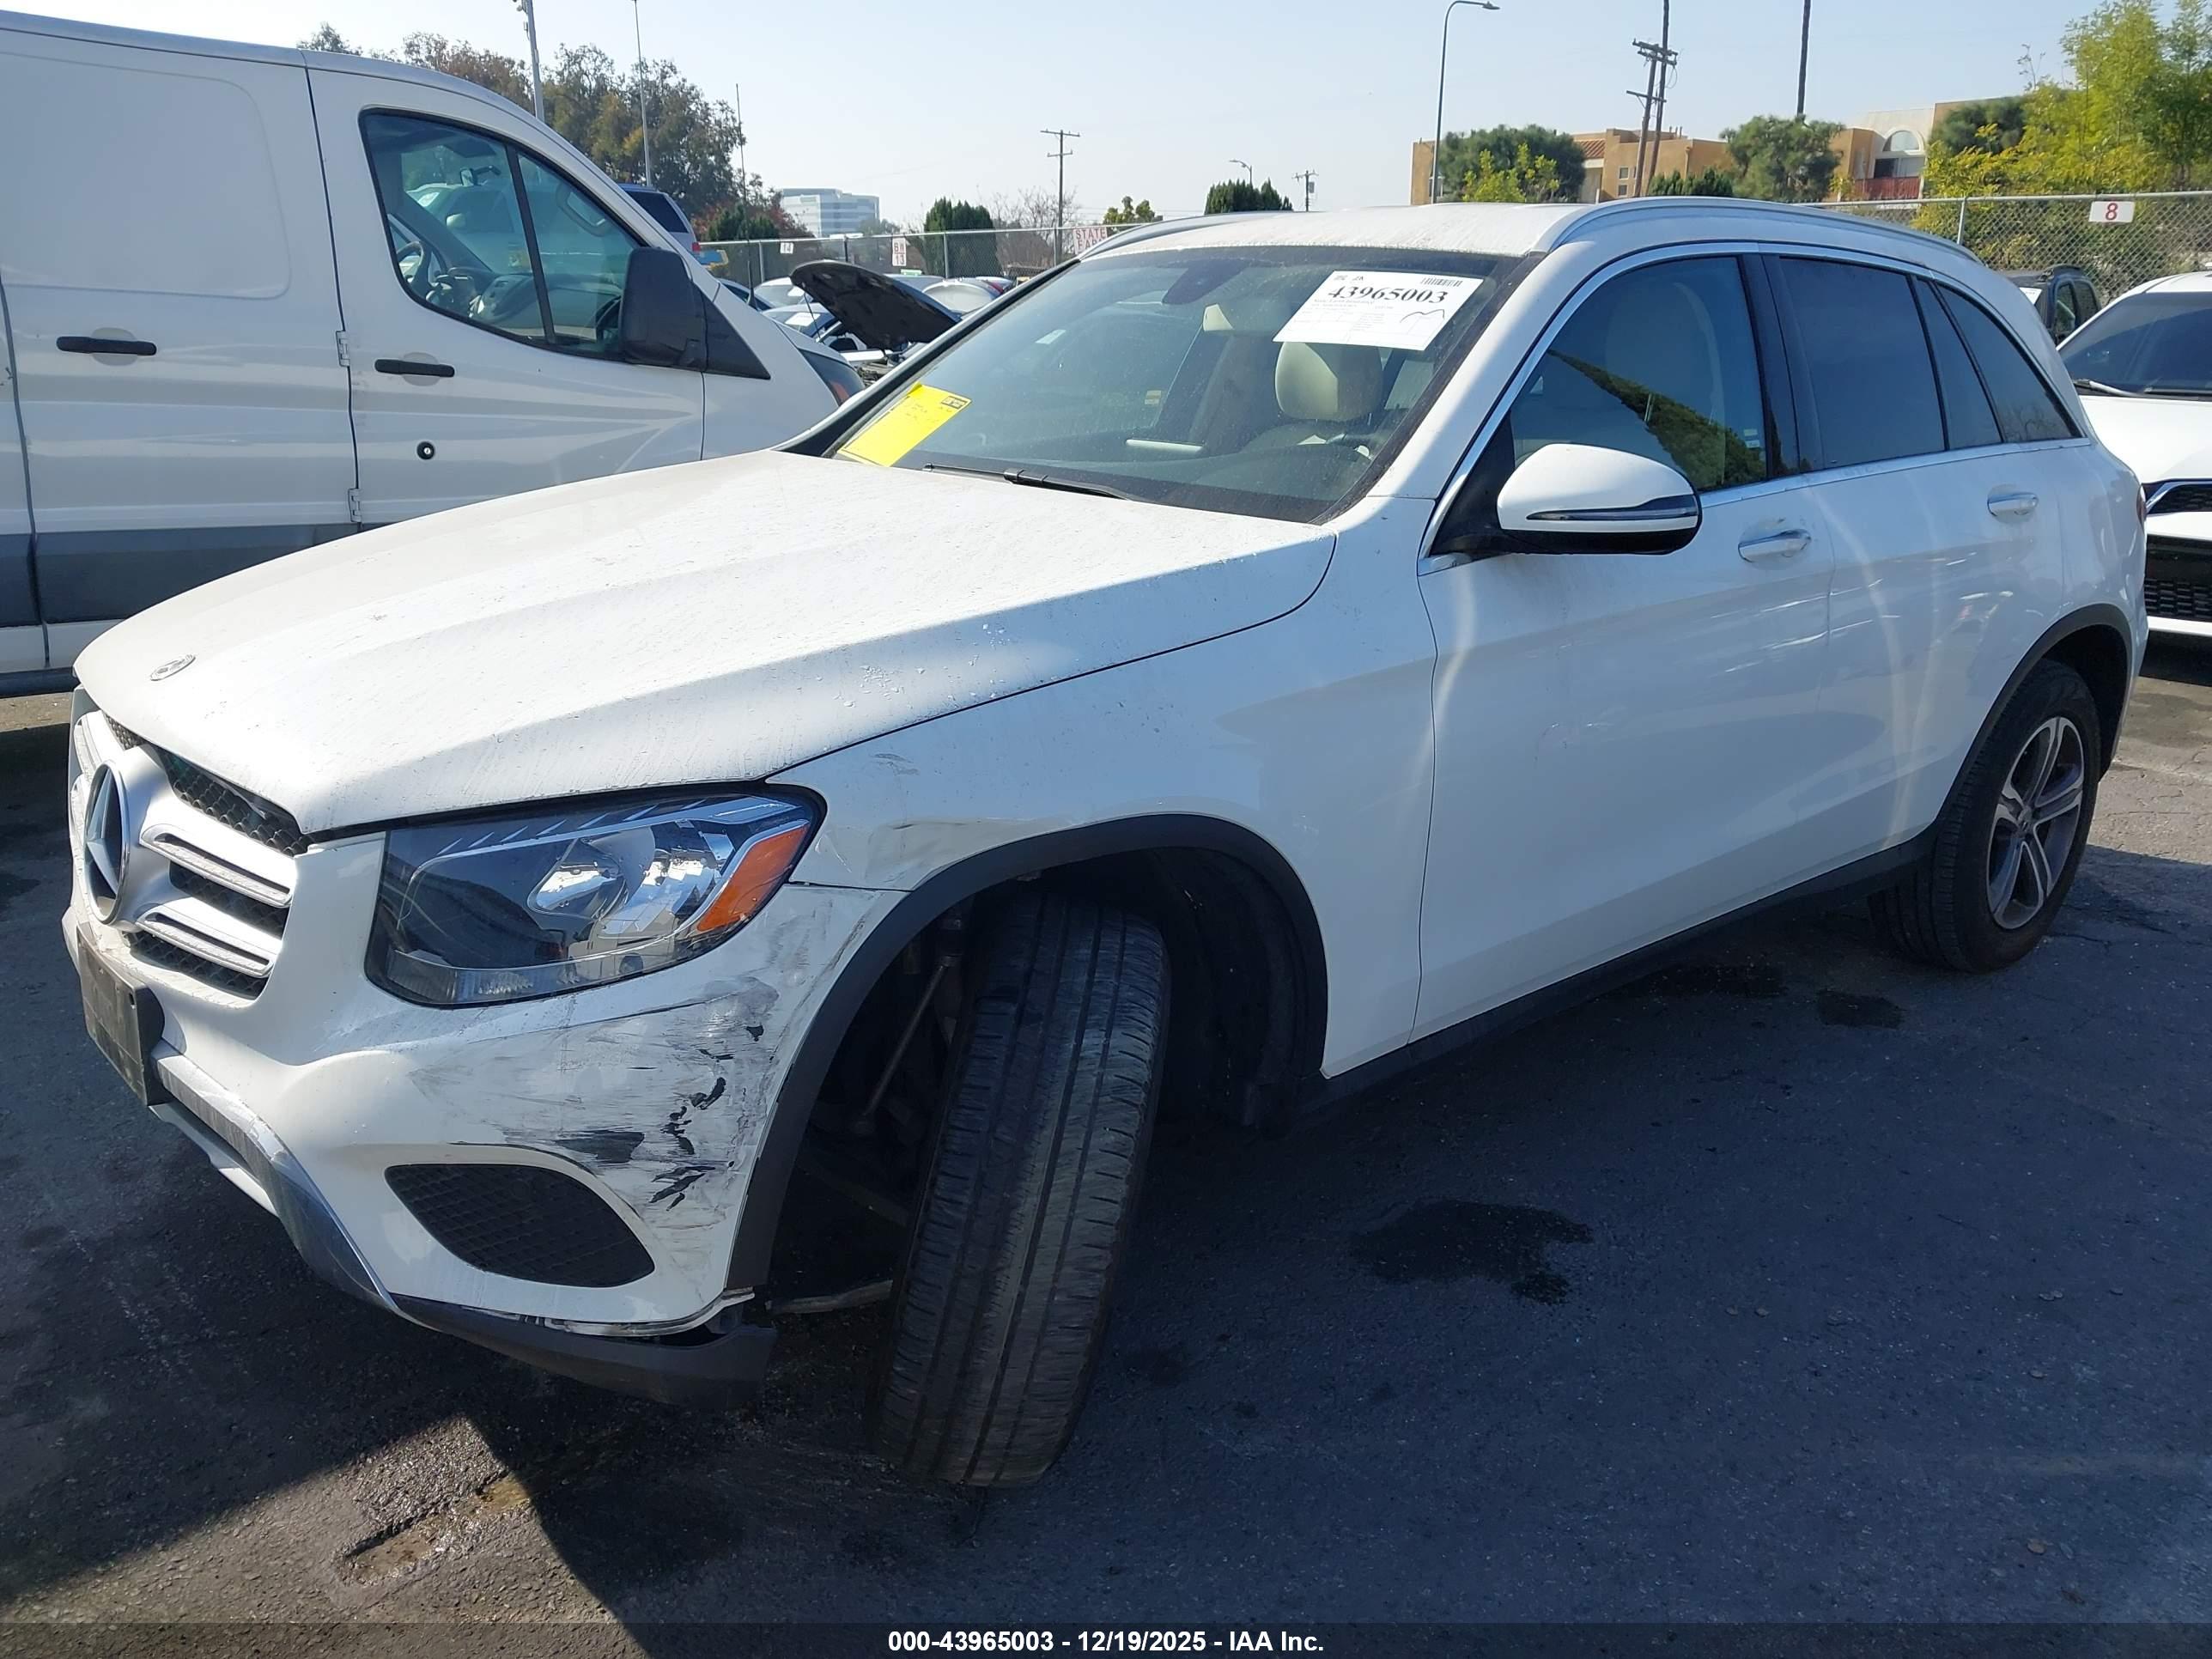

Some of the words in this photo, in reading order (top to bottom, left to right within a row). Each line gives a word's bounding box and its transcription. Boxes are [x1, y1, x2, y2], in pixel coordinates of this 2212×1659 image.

[2106, 203, 2118, 221] 8
[1075, 228, 1106, 240] STATE
[895, 254, 904, 265] 13
[1328, 285, 1448, 304] 43965003
